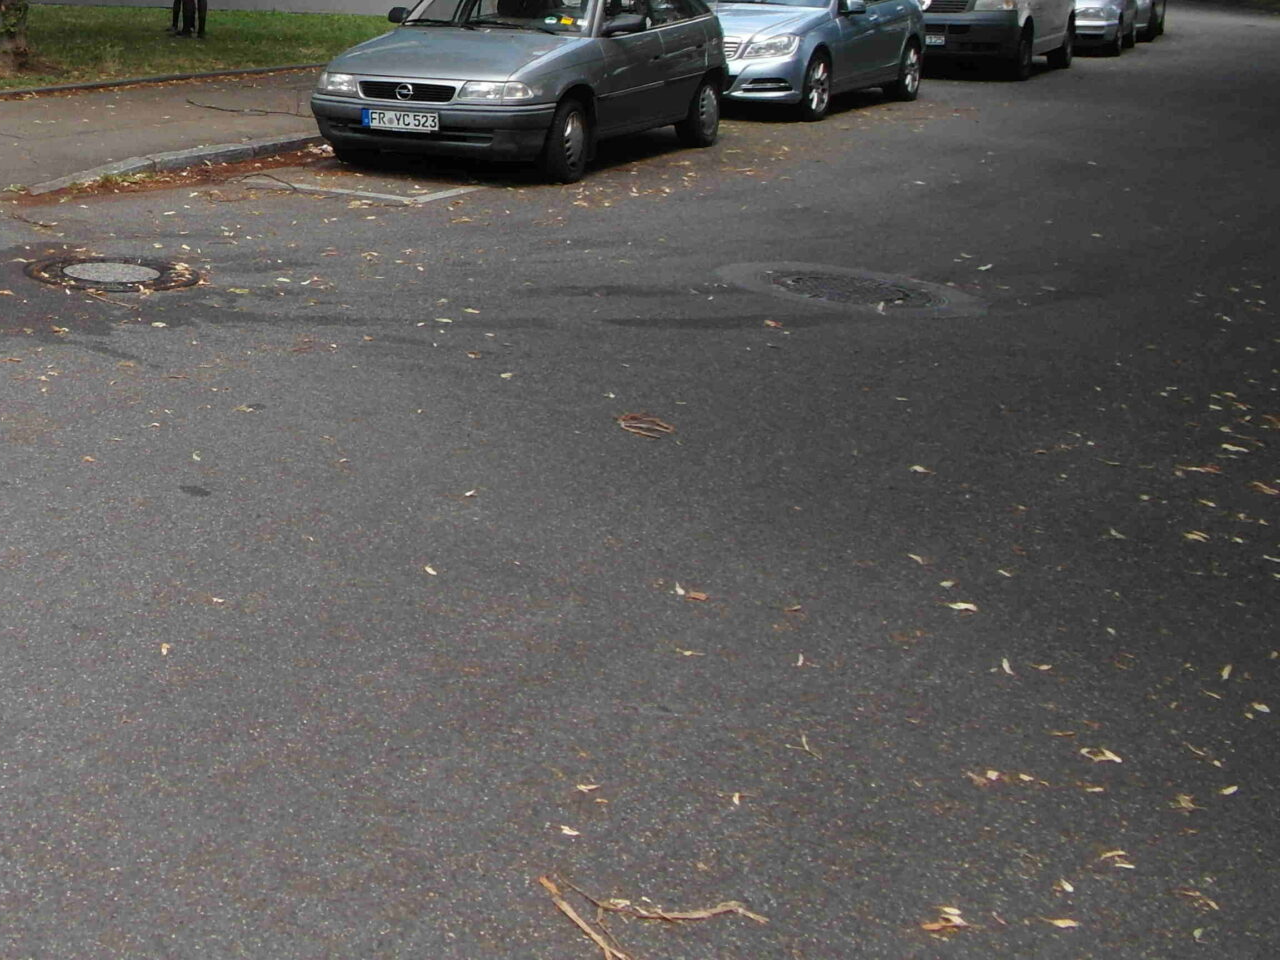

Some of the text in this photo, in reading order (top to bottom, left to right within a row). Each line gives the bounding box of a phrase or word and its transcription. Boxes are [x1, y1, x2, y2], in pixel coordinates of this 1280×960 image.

[370, 111, 437, 128] FR YC 523
